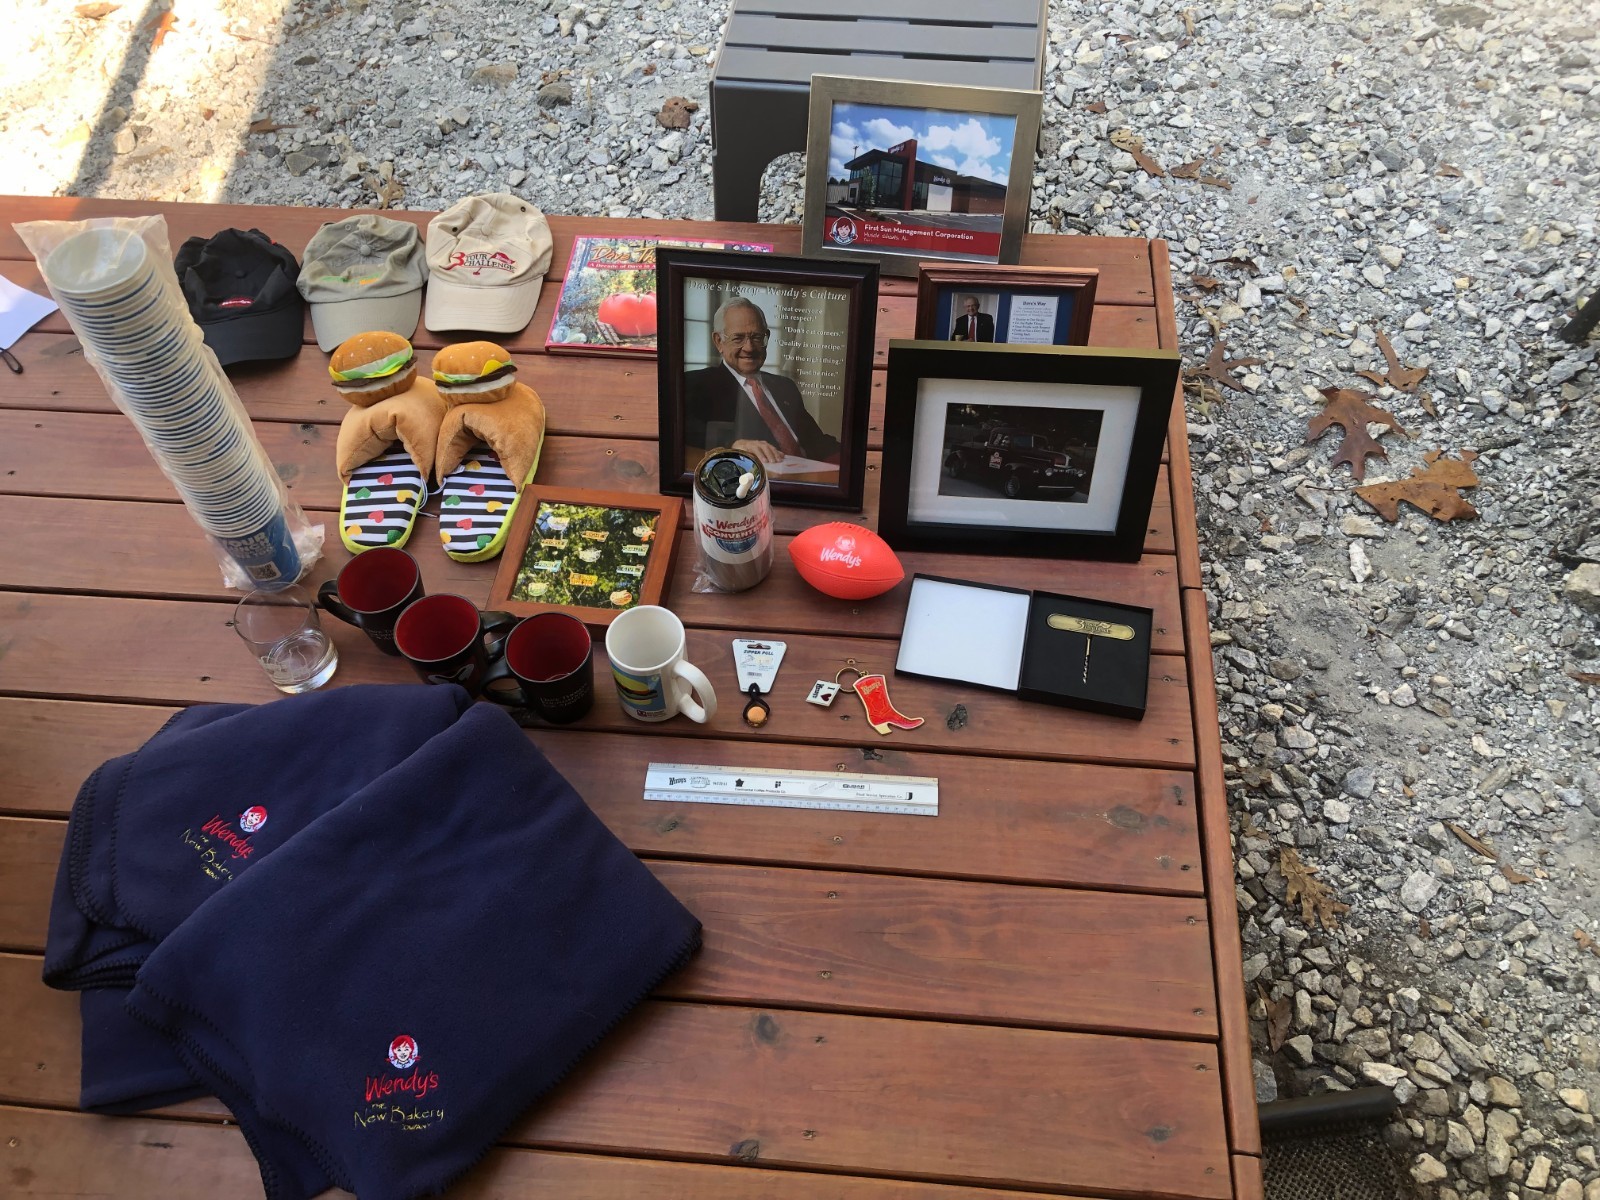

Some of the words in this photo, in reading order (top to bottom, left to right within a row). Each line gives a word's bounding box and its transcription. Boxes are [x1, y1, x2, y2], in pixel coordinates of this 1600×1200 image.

[864, 223, 879, 231] First
[893, 227, 933, 236] Management
[935, 230, 974, 240] Corporation
[438, 251, 467, 271] 3
[464, 253, 488, 261] TOUR
[589, 246, 632, 262] Dave
[463, 260, 518, 273] CHALLENGE
[689, 280, 723, 292] Dave's
[724, 283, 760, 297] Legacy
[767, 285, 808, 299] Wendy's
[809, 288, 848, 301] Culture
[706, 524, 764, 540] CONVENTI
[820, 546, 862, 569] Wendy's
[179, 828, 202, 850] New
[201, 814, 254, 859] Wendy's
[364, 1066, 439, 1102] Wendy's
[353, 1107, 388, 1130] New
[390, 1105, 445, 1124] Bakery
